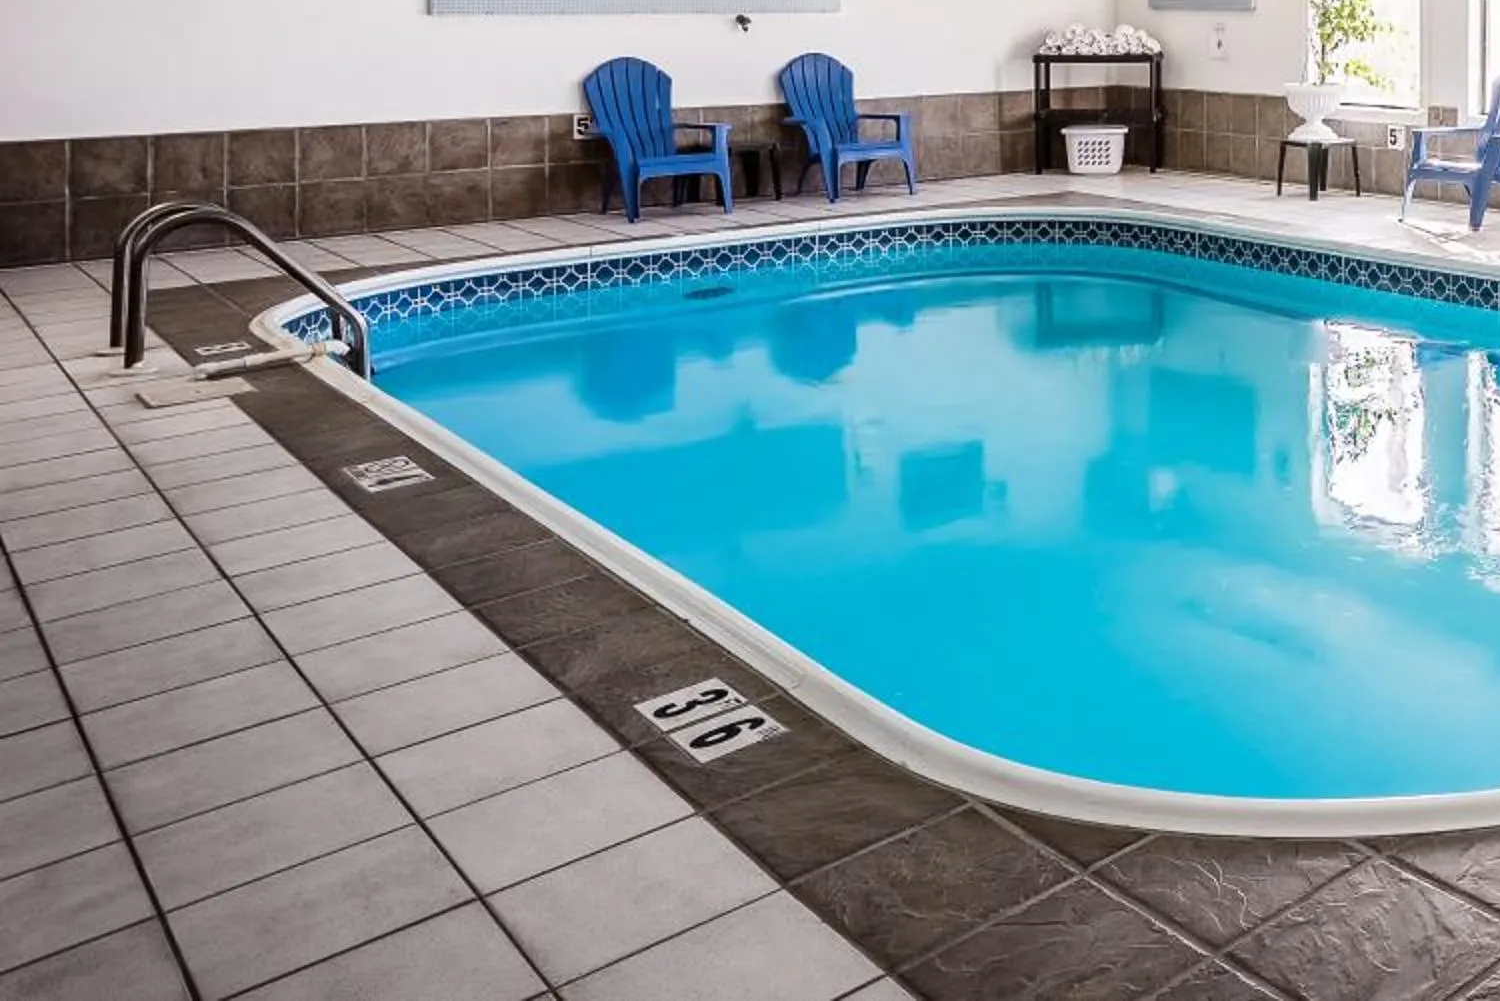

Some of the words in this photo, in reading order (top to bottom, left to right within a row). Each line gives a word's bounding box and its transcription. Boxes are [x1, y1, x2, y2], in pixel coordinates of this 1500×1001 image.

[1389, 128, 1397, 146] 5
[652, 688, 729, 719] 3
[688, 716, 766, 749] 6
